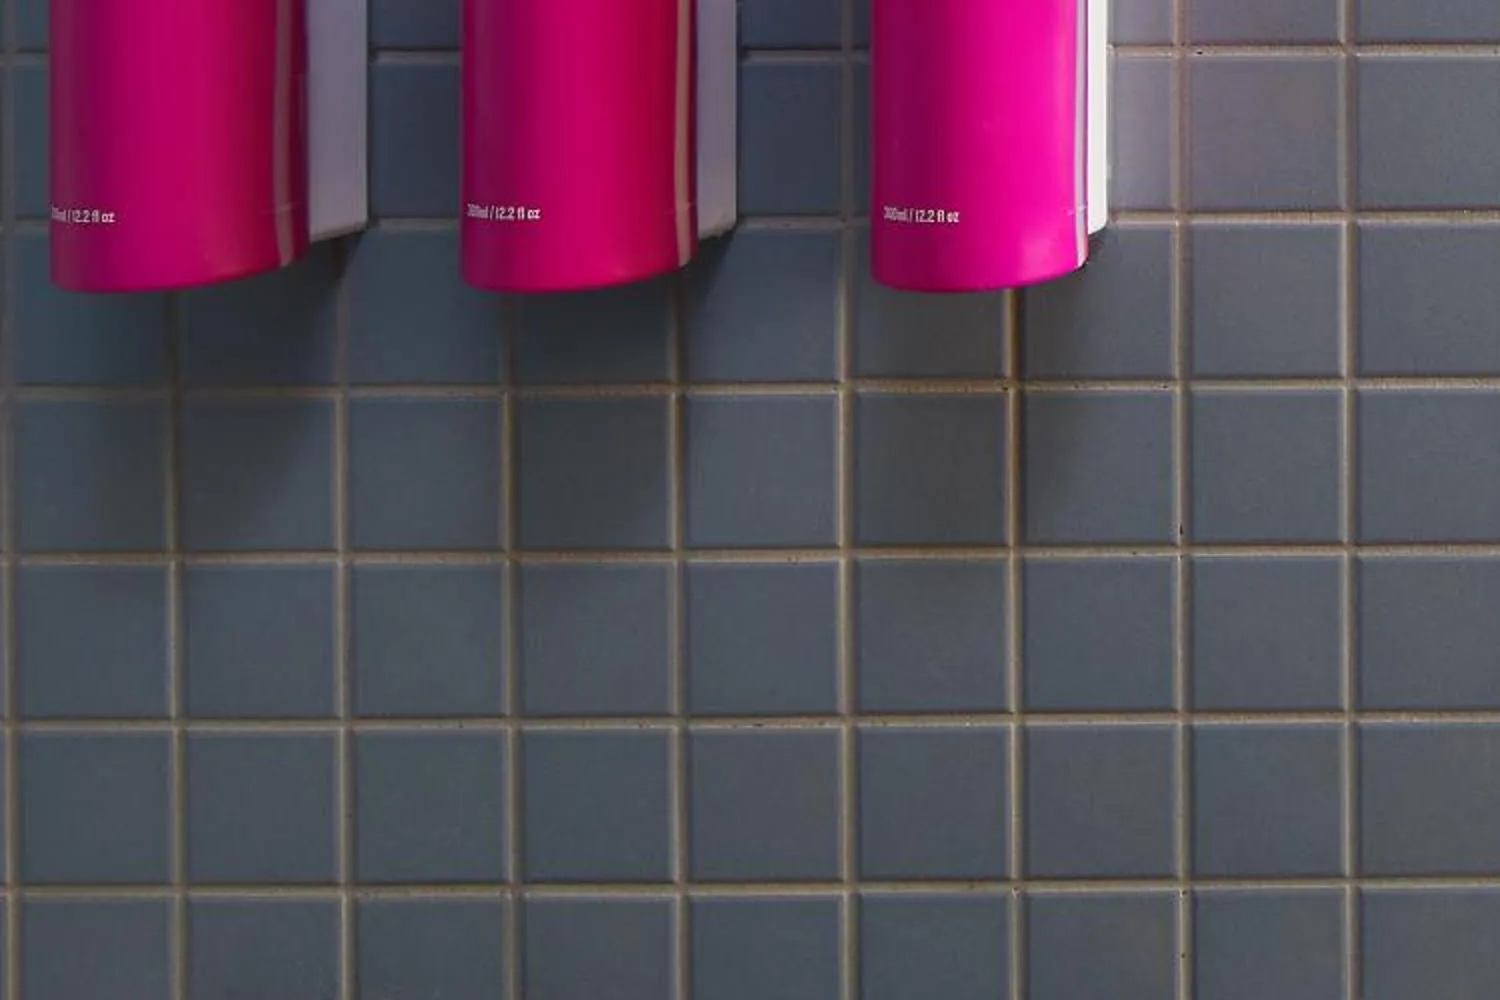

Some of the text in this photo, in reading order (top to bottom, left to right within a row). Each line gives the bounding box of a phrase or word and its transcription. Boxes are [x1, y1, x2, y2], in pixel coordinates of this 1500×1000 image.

[102, 212, 117, 223] oz
[527, 209, 541, 219] oz
[947, 211, 960, 223] oz
